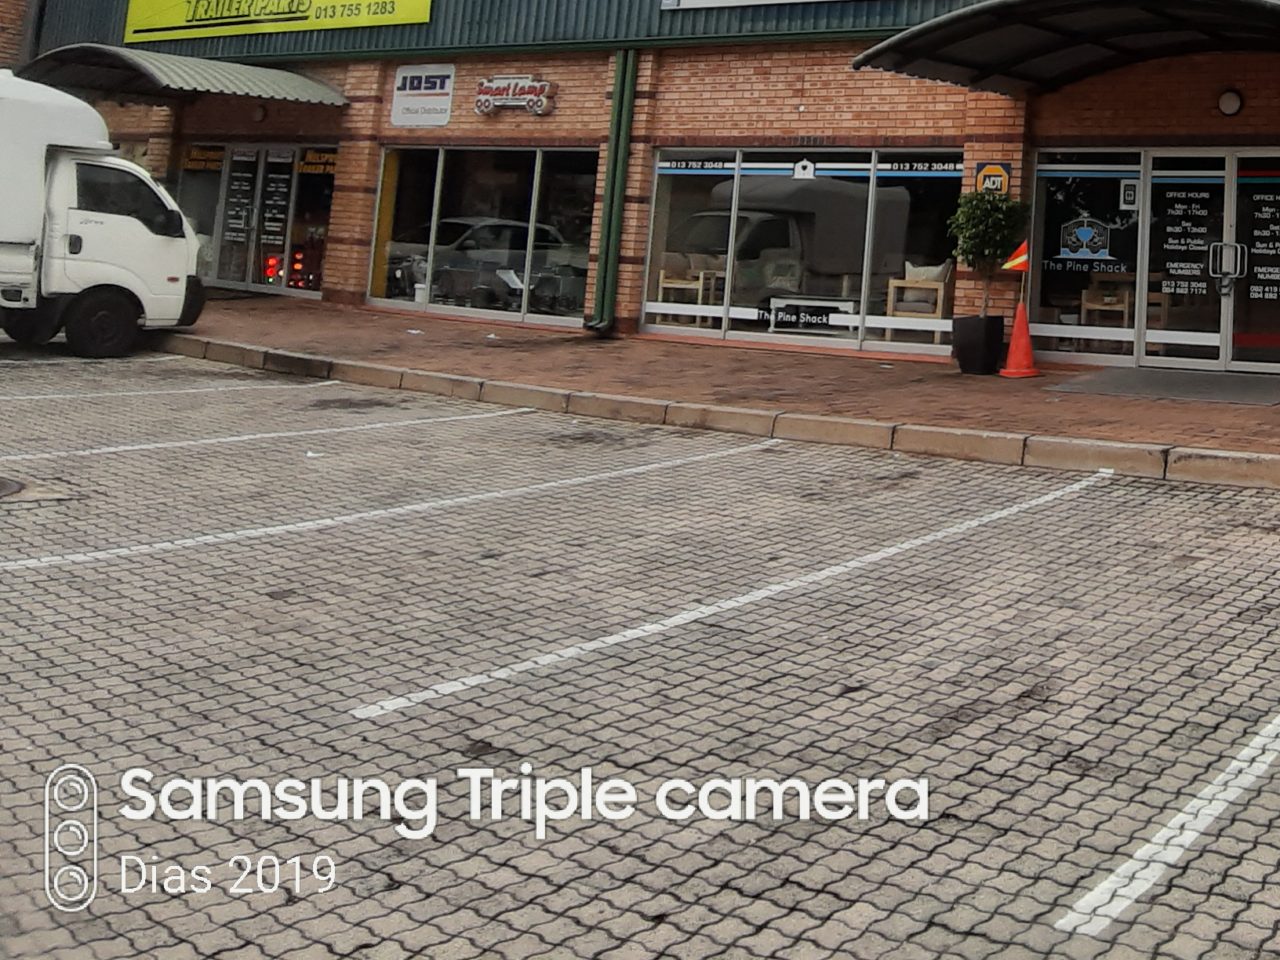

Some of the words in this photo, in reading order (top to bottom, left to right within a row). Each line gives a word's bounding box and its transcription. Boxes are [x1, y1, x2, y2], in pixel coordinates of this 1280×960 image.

[314, 5, 338, 19] 013
[339, 3, 361, 17] 755
[366, 0, 396, 15] 1283
[396, 74, 450, 92] JOST
[670, 161, 686, 169] 013
[892, 162, 910, 171] 013
[931, 162, 954, 171] 3048
[982, 176, 1003, 189] ADT
[1043, 259, 1062, 271] The
[1066, 260, 1089, 272] Pine
[1092, 260, 1127, 272] Shack
[777, 311, 797, 322] Pine
[800, 313, 829, 324] Shack
